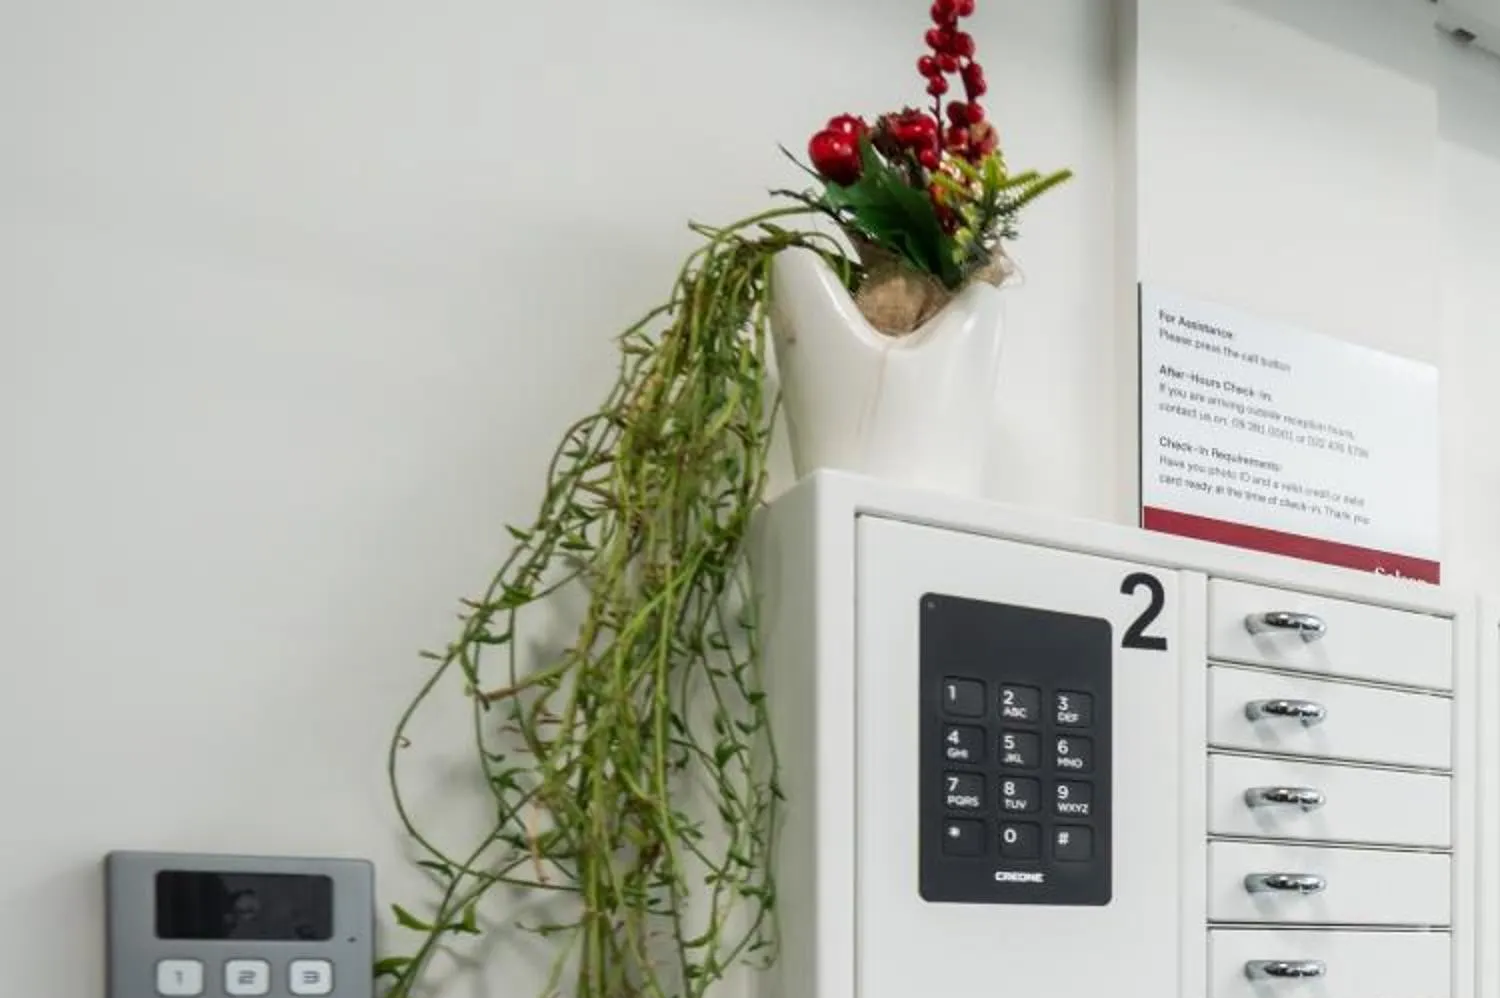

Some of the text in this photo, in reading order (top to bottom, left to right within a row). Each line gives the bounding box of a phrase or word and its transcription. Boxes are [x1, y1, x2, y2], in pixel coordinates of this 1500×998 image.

[1159, 309, 1175, 323] For
[1159, 327, 1193, 346] Please
[1194, 339, 1221, 353] press
[1223, 345, 1239, 358] the
[1241, 353, 1258, 364] call
[1159, 381, 1166, 393] If
[1168, 387, 1187, 400] you
[1189, 391, 1205, 402] are
[1207, 396, 1244, 415] arriving
[1159, 402, 1197, 418] contact
[1159, 435, 1209, 456] Check-in
[1159, 455, 1185, 469] Have
[1208, 466, 1237, 480] photo
[1239, 471, 1251, 482] ID
[1252, 476, 1271, 487] and
[1159, 474, 1182, 487] card
[1184, 479, 1212, 496] ready
[1226, 486, 1243, 499] the
[1244, 489, 1266, 504] time
[1267, 494, 1277, 505] of
[1119, 571, 1168, 651] 2
[948, 684, 1069, 711] 1 2 3
[1003, 706, 1079, 723] ABC DEF
[947, 729, 1069, 755] 4 5 6
[1056, 757, 1083, 769] MNO
[947, 777, 1069, 800] 7 8 9
[946, 795, 1089, 815] PQRS TUV WXYZ
[1003, 828, 1017, 844] 0
[238, 969, 258, 986] 2
[302, 969, 321, 985] 3
